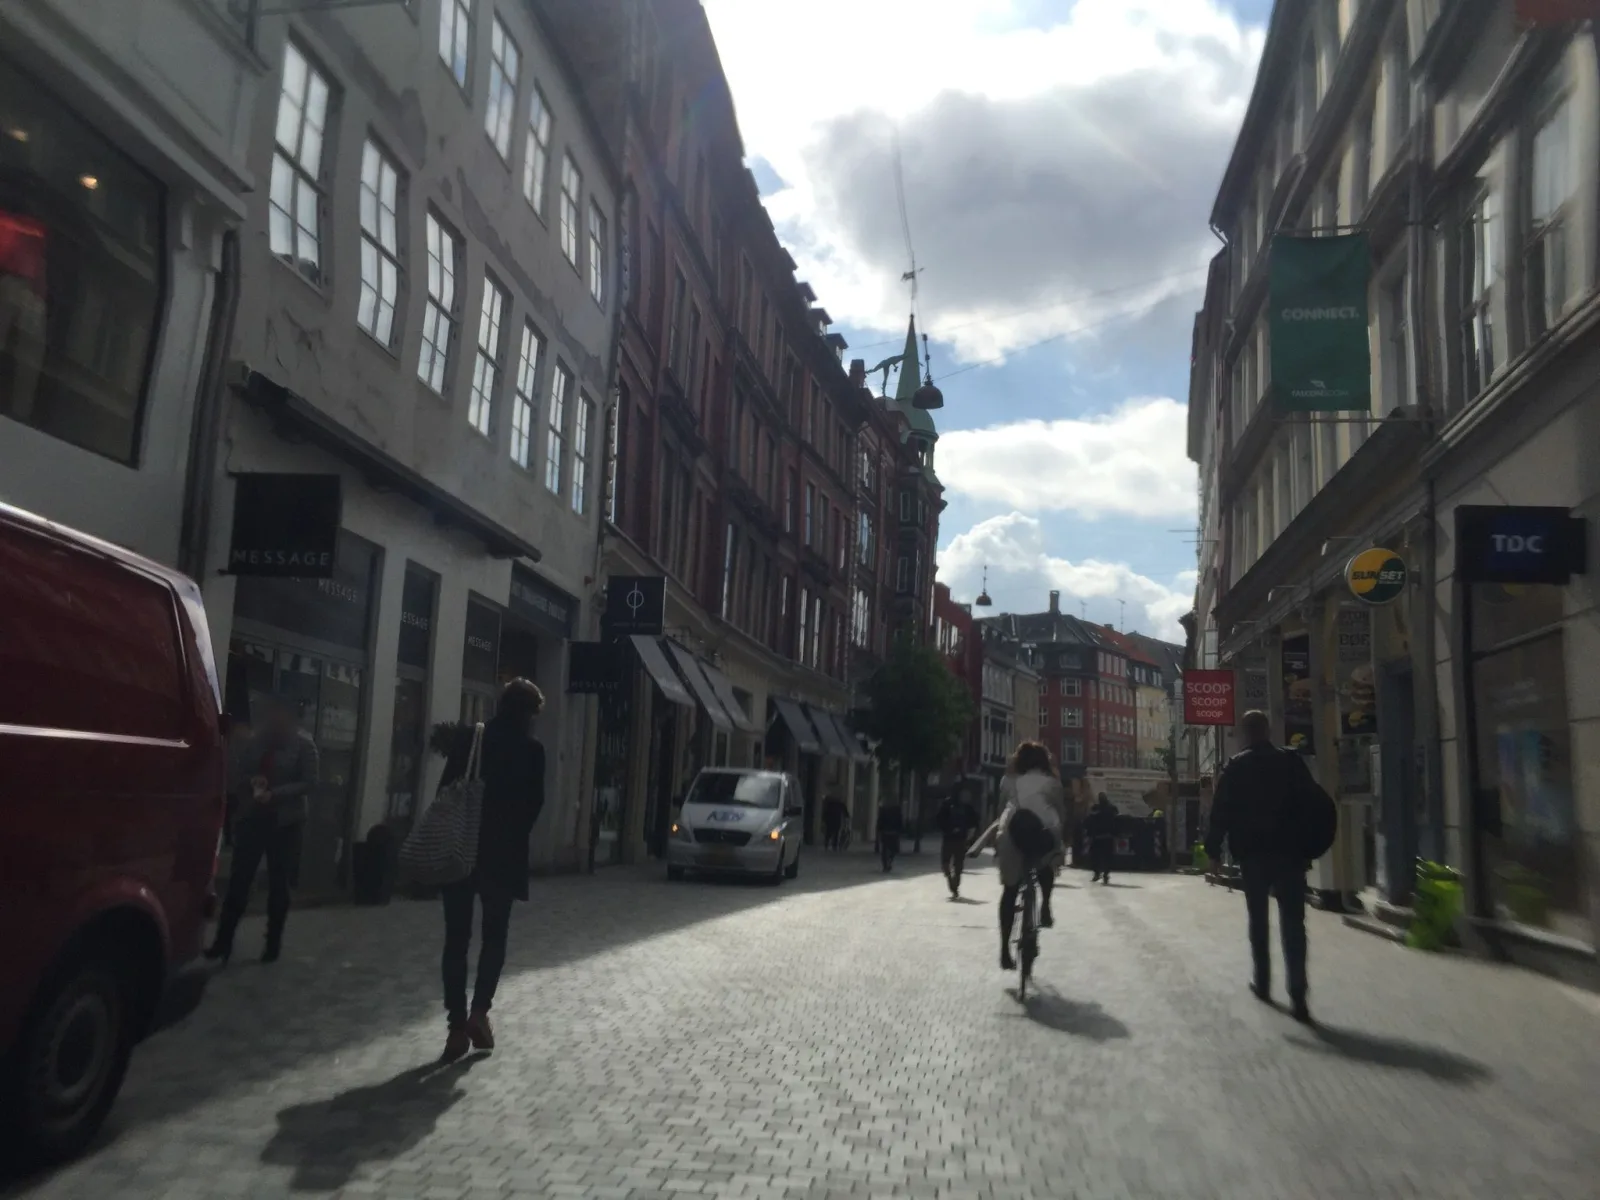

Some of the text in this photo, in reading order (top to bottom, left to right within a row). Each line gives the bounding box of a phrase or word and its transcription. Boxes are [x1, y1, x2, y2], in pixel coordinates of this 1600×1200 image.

[1491, 534, 1544, 553] TDC
[231, 549, 331, 566] MESSAGE
[1352, 571, 1404, 580] SUNSET
[569, 681, 621, 691] MESSAGE
[1186, 682, 1232, 694] SCOOP
[1191, 697, 1227, 707] SCOOP
[1196, 710, 1224, 718] SCOOP
